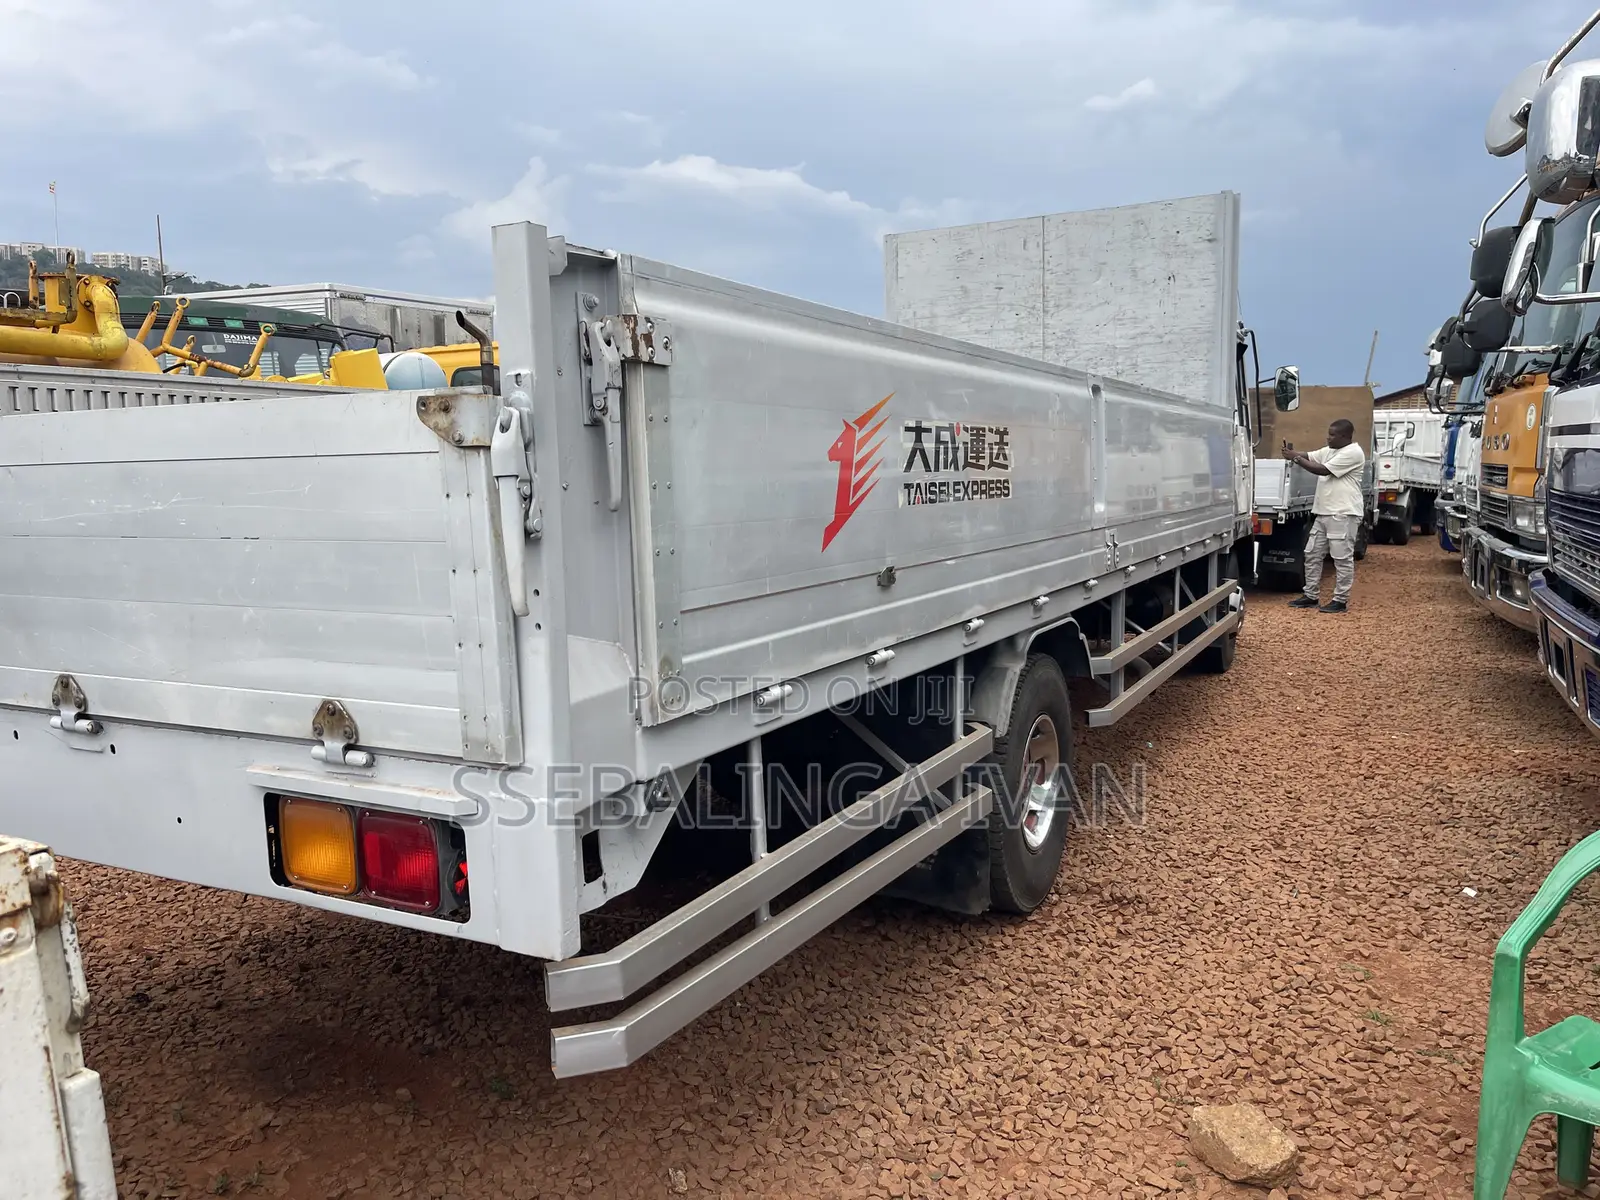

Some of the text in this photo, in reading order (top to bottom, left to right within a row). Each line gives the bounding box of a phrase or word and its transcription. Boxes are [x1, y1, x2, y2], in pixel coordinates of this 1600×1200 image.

[903, 420, 1009, 473] 大成運送
[952, 478, 1010, 501] EXPRESS
